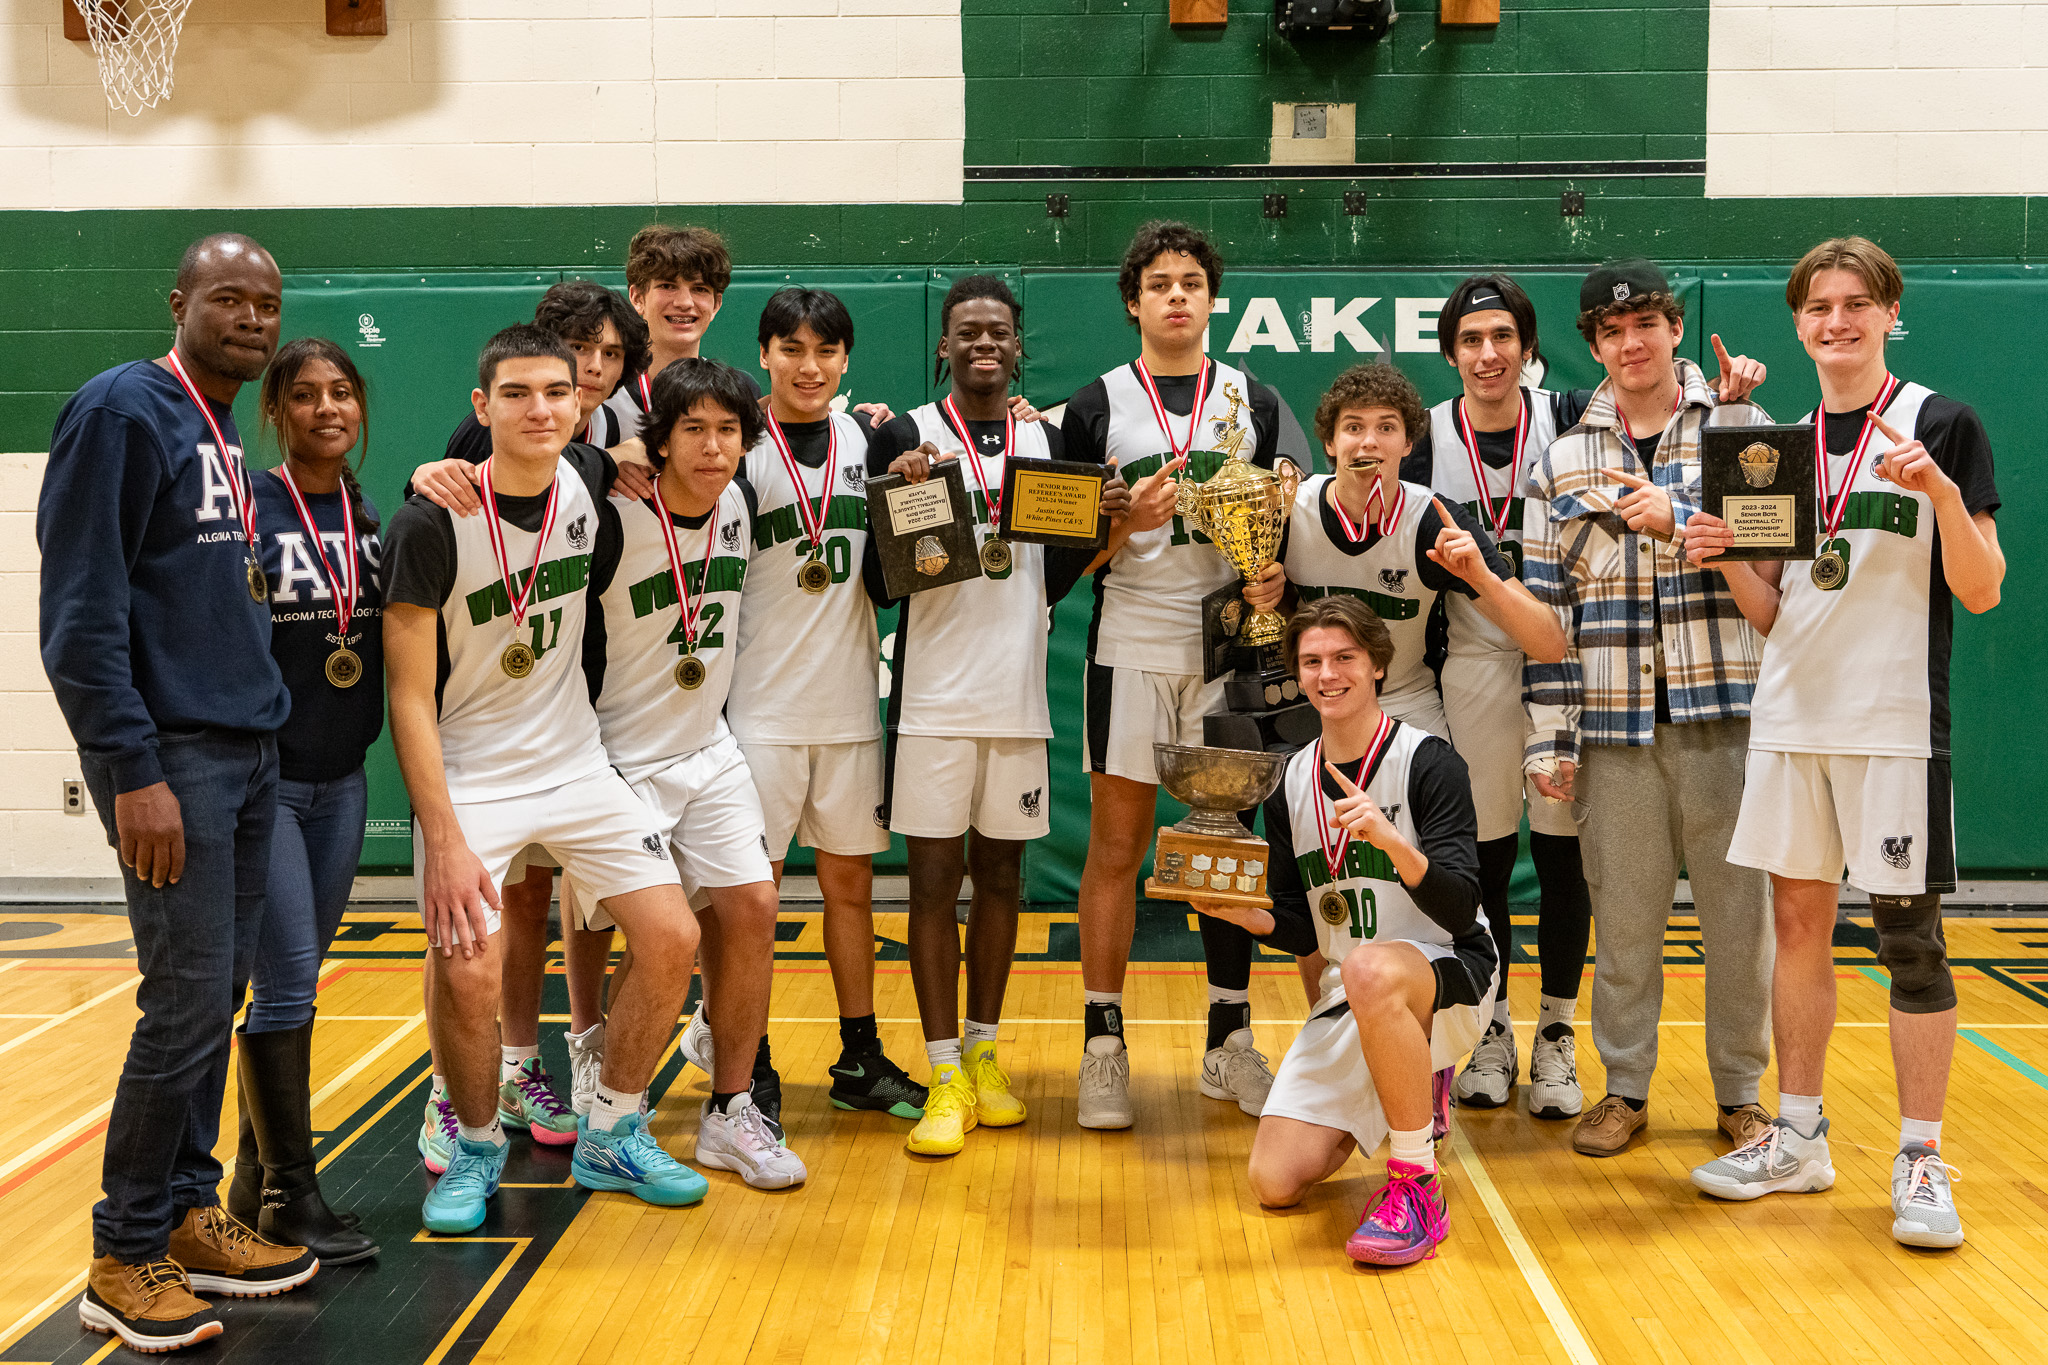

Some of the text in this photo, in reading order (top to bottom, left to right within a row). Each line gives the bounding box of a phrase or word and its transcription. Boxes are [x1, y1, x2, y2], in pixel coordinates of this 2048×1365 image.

[1037, 482, 1061, 491] SENIOR
[1028, 489, 1063, 498] REFEREE'S
[1035, 507, 1055, 515] Justin
[1026, 514, 1044, 522] White
[1045, 515, 1062, 523] Pines
[271, 612, 315, 624] ALGOMA
[317, 607, 374, 620] TECHLOGY
[667, 601, 724, 656] 42
[1340, 887, 1378, 940] 10
